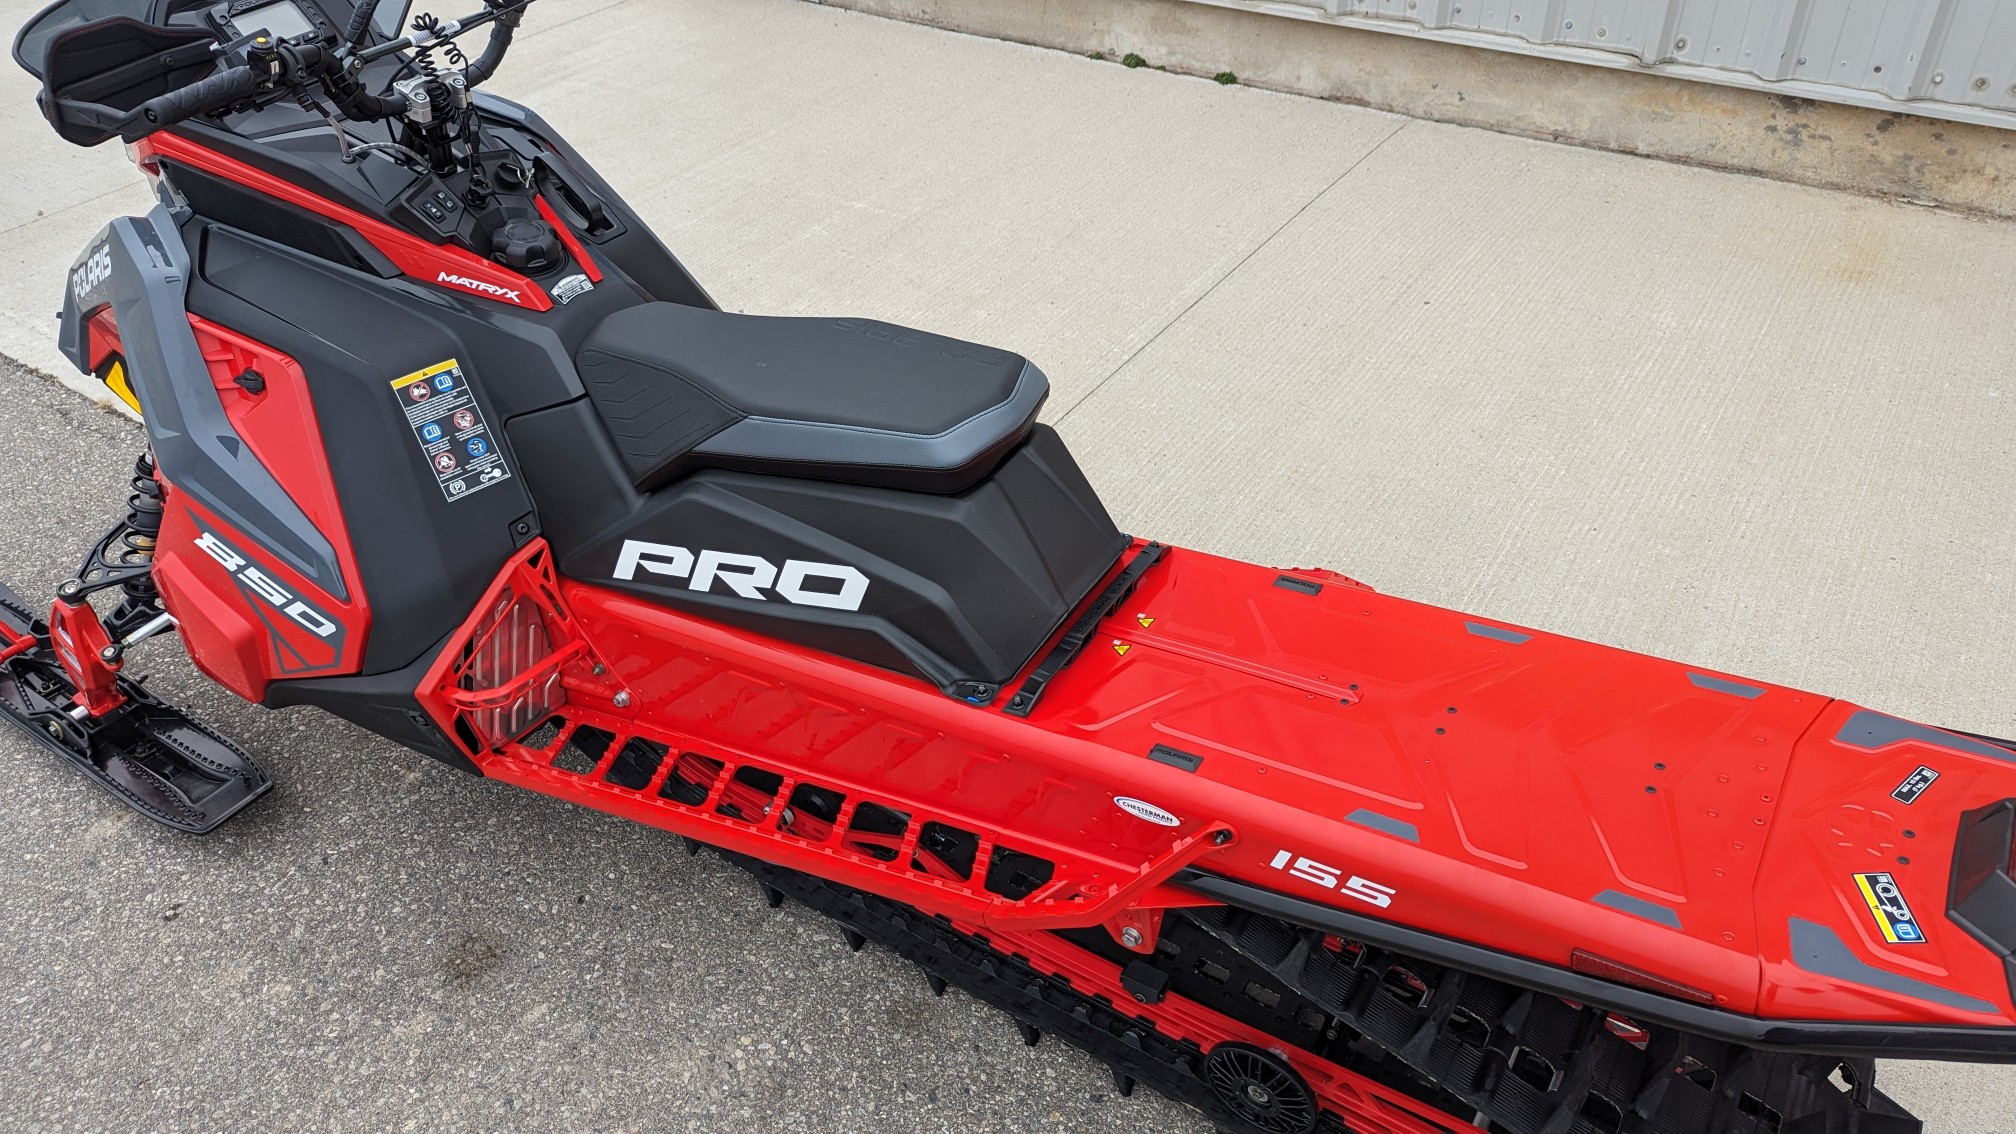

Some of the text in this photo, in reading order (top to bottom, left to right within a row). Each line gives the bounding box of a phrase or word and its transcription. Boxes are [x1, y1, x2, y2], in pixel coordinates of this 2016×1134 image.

[72, 243, 112, 303] POLARIS
[437, 271, 521, 303] MATRYX
[193, 531, 337, 638] 850
[612, 539, 870, 612] PRO
[1155, 747, 1194, 763] POLARIS
[1122, 801, 1174, 823] CHESTERMAN
[1269, 849, 1397, 909] 155
